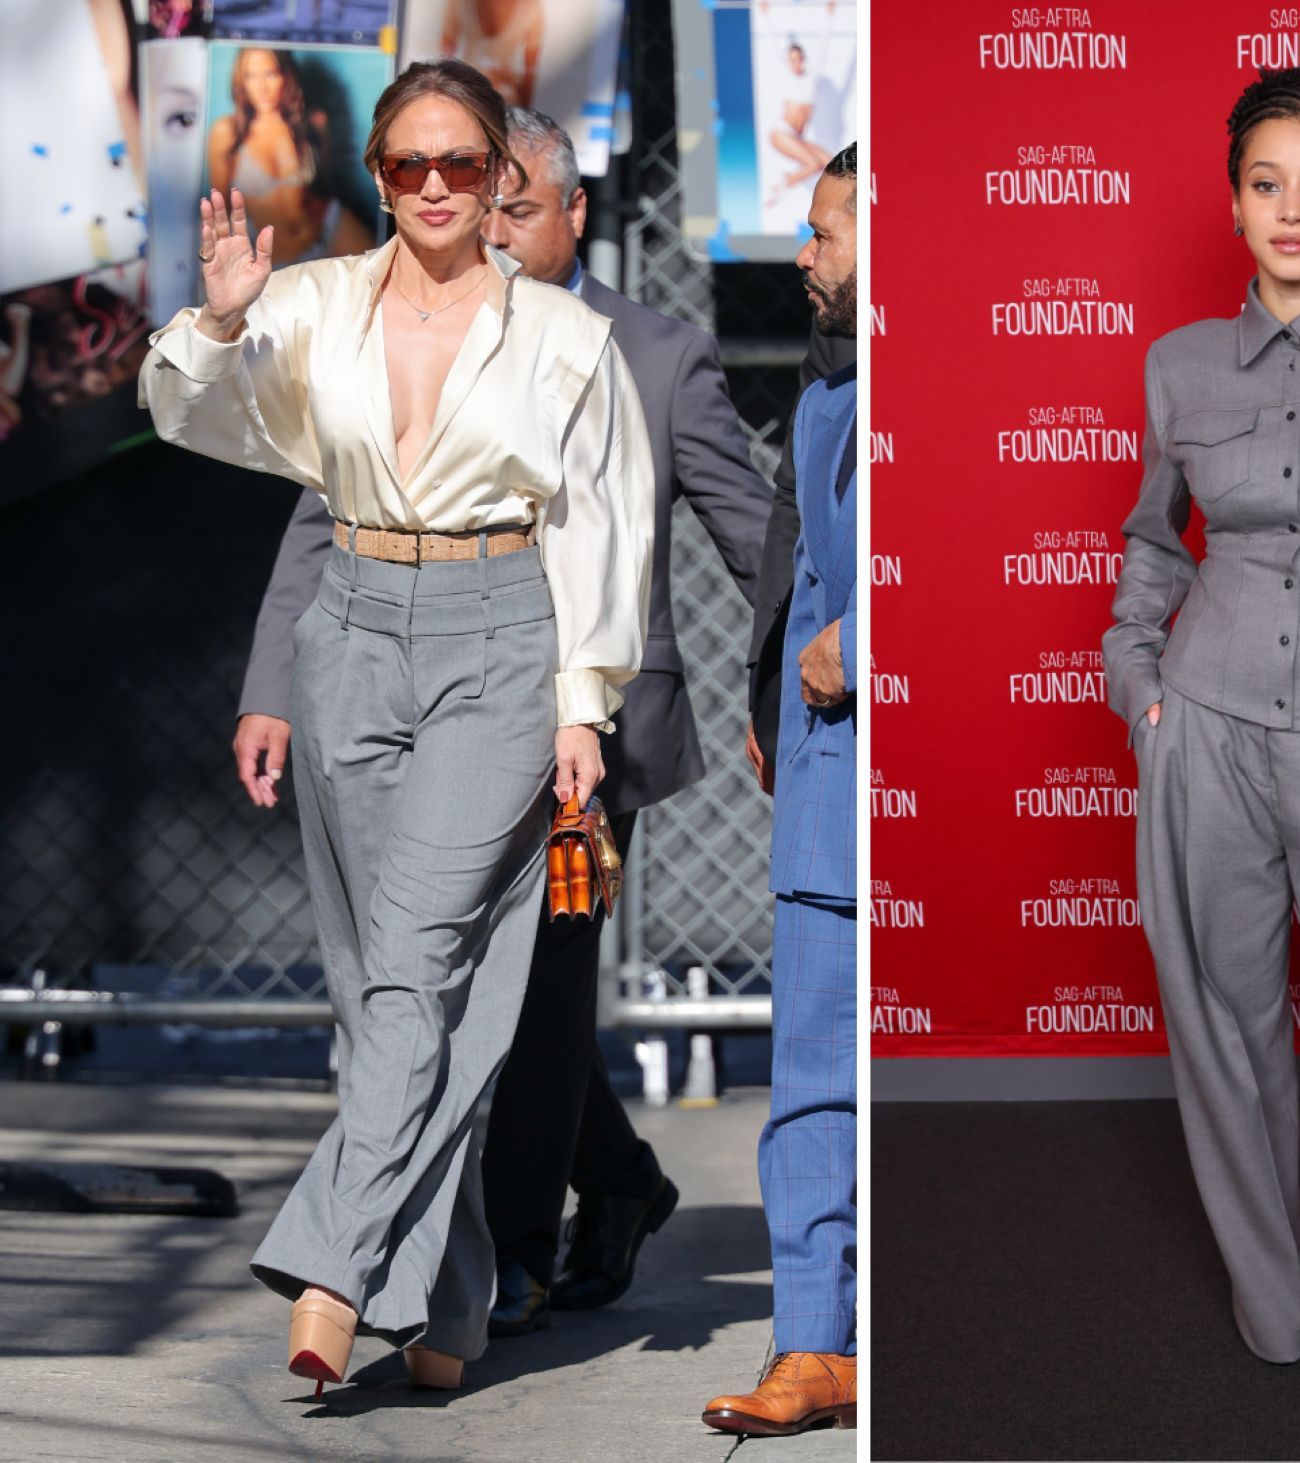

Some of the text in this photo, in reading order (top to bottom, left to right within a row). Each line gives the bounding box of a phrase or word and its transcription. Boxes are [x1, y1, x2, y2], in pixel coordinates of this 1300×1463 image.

[1012, 8, 1091, 28] SAG-AFTRA
[980, 32, 1126, 69] FOUNDATION
[1018, 146, 1096, 165] SAG-AFTRA
[986, 169, 1129, 204] FOUNDATION
[1023, 278, 1100, 297] SAG-AFTRA
[992, 301, 1133, 335] FOUNDATION
[1029, 406, 1104, 425] SAG-AFTRA
[998, 428, 1137, 462] FOUNDATION
[1034, 531, 1108, 550] SAG-AFTRA
[1004, 552, 1123, 584] FOUNDATIO
[1040, 651, 1103, 669] SAG-AFTR
[1010, 672, 1105, 702] FOUNDAT
[1045, 767, 1116, 784] SAG-AFTRA
[1050, 879, 1120, 895] SAG-AFTRA
[1021, 897, 1140, 926] FOUNDATIO
[1054, 986, 1123, 1002] SAG-AFTRA
[871, 1006, 931, 1033] ATION
[1026, 1005, 1153, 1032] FOUNDATION
